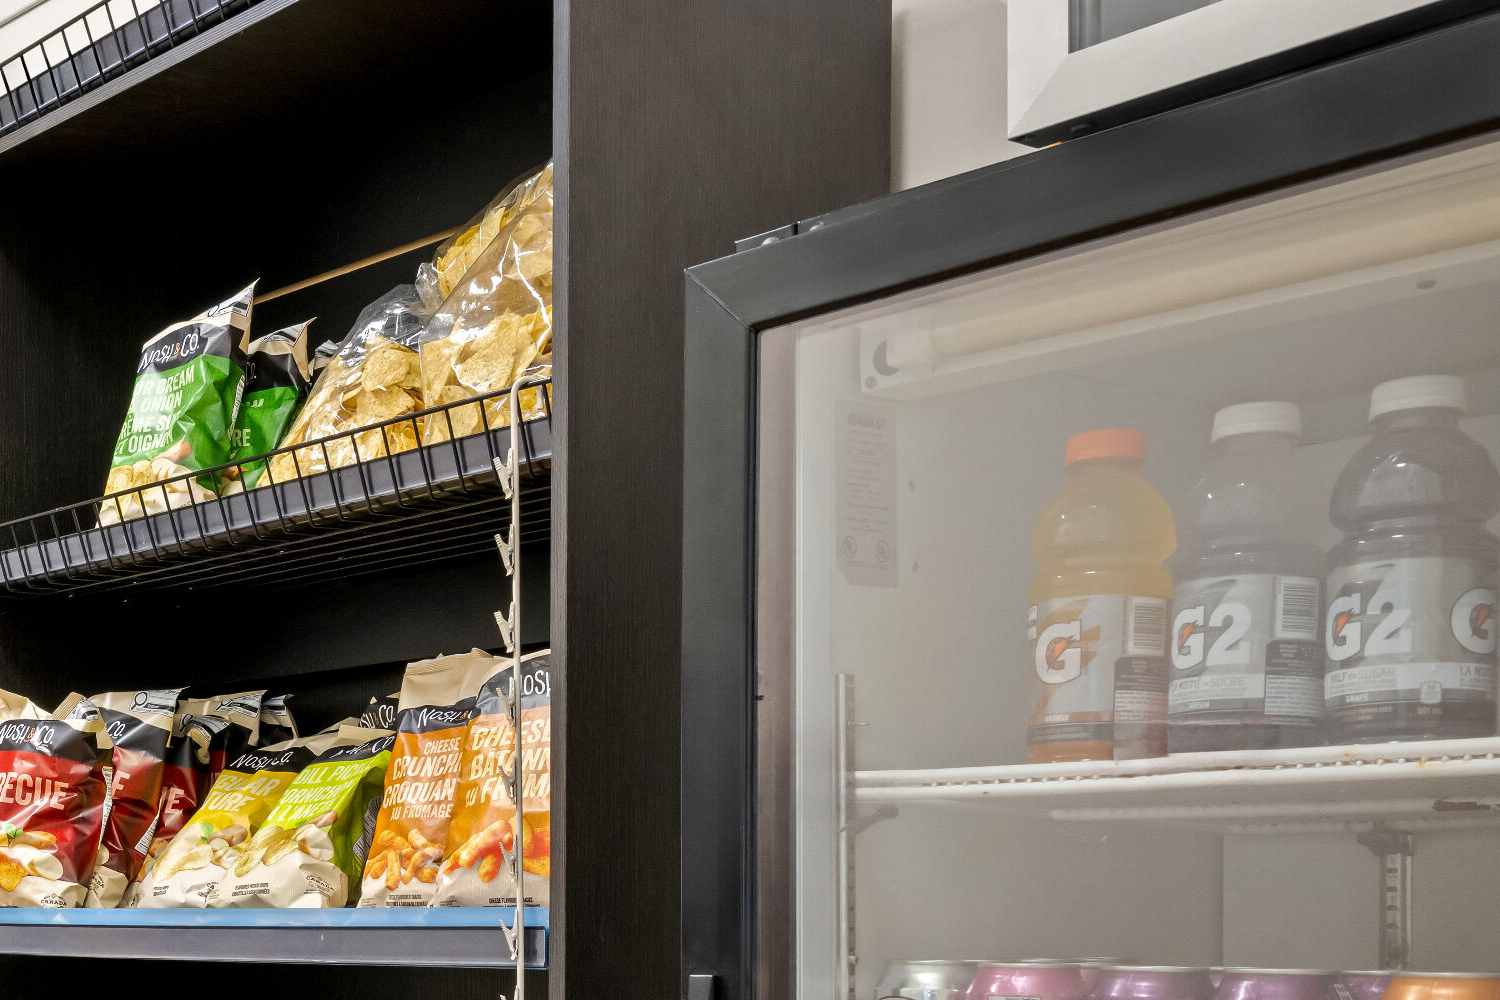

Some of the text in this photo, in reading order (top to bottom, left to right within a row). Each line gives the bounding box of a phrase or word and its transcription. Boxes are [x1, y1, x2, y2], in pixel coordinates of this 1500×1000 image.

[137, 342, 174, 374] NOSH
[156, 365, 195, 395] CREAM
[1325, 592, 1412, 662] G2
[1451, 588, 1497, 655] G
[1172, 601, 1252, 670] G2
[1035, 619, 1082, 684] G
[1210, 675, 1244, 688] SUCRE
[1358, 667, 1395, 680] SUGAR
[379, 704, 396, 729] CO.
[417, 708, 460, 729] NOSH
[1045, 713, 1069, 723] ORANGE
[424, 737, 461, 755] CHEESE
[292, 767, 329, 785] DILL
[390, 803, 453, 820] AU FROMAGE
